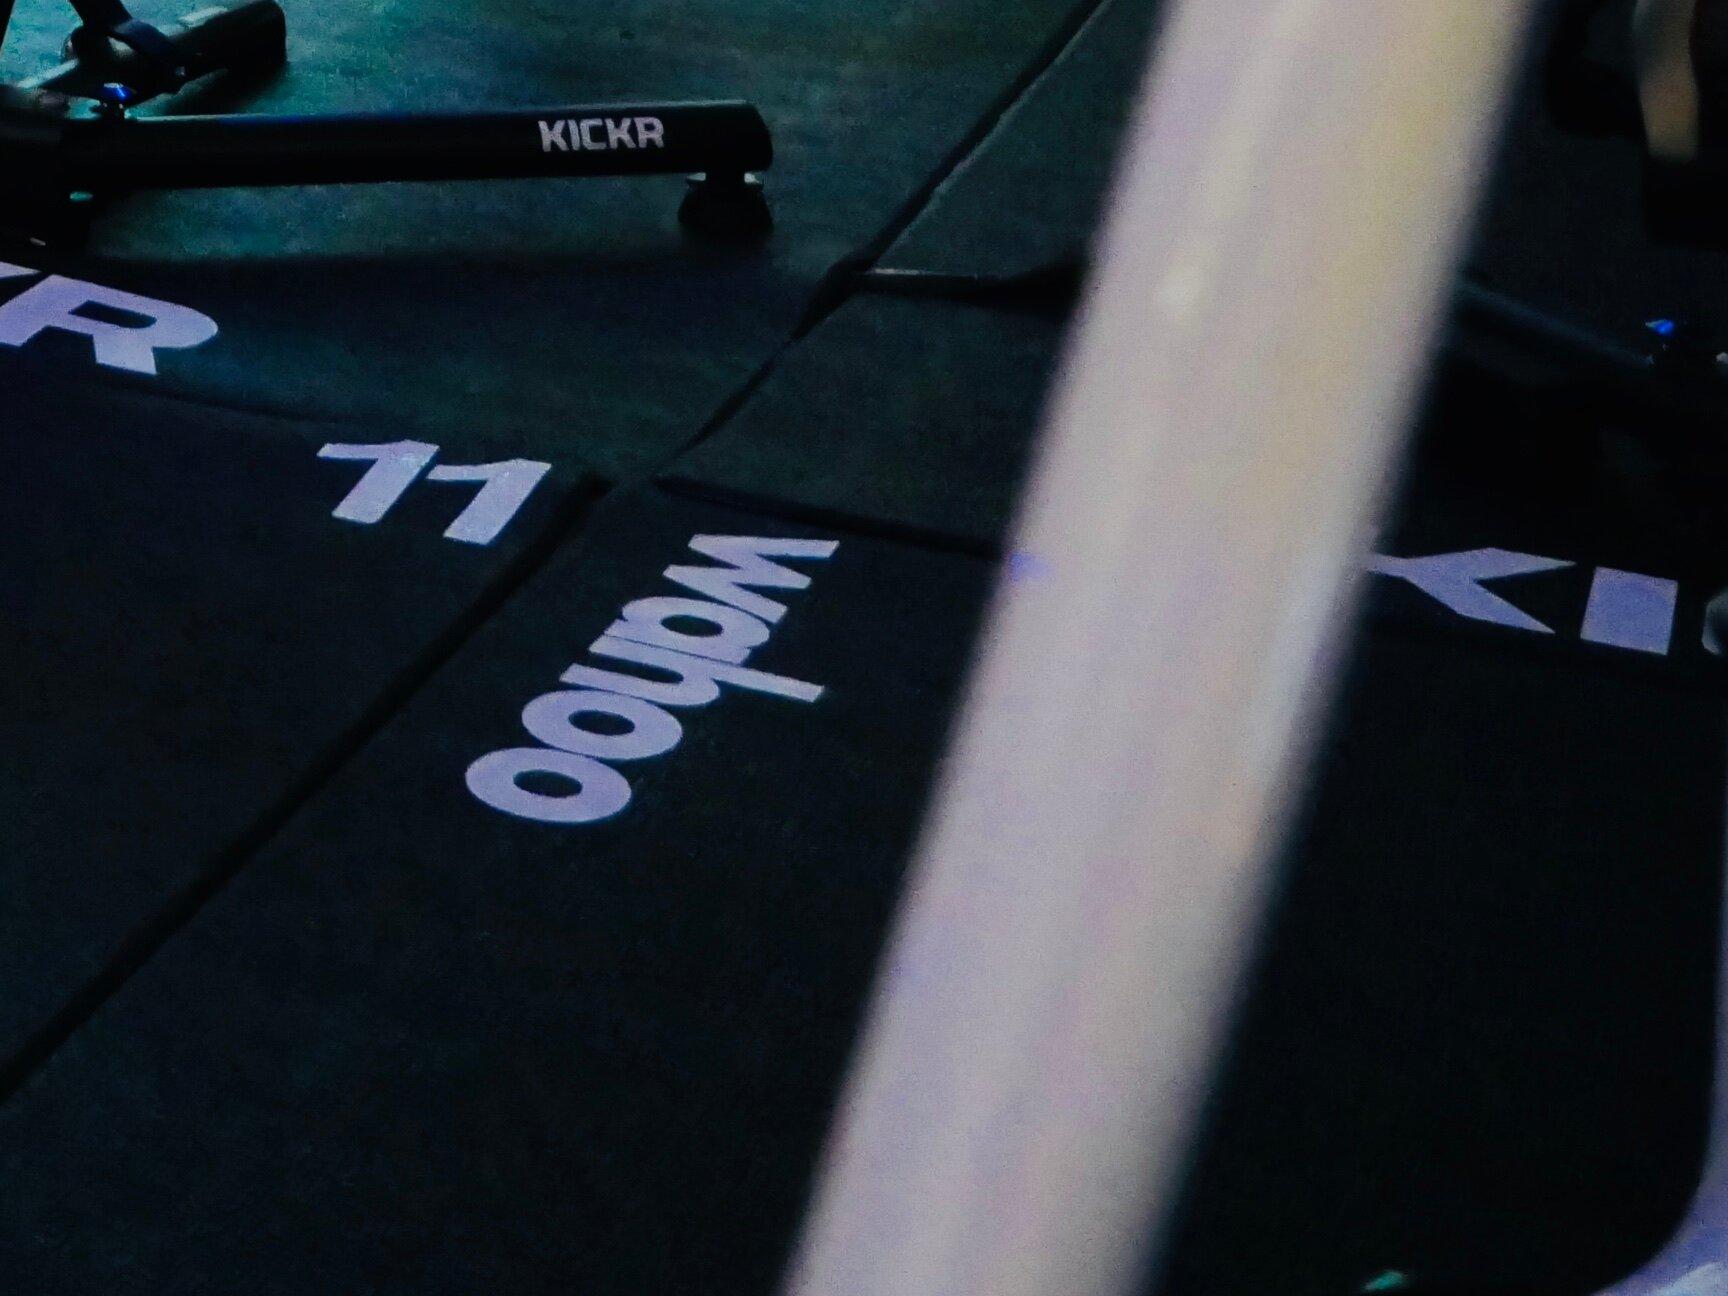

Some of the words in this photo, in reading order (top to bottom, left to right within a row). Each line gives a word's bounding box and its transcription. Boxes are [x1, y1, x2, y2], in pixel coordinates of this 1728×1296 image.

[539, 116, 667, 153] KICKR
[316, 419, 552, 546] 11
[464, 532, 841, 825] wahoo
